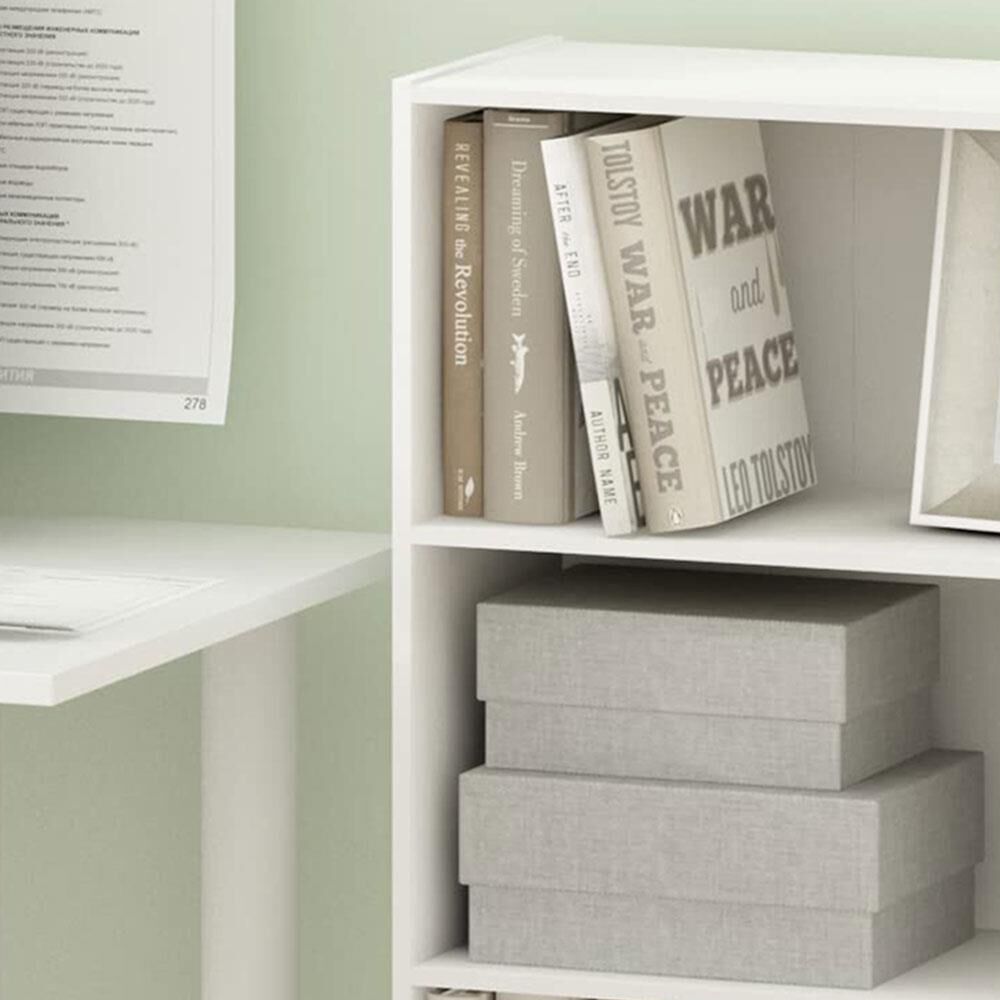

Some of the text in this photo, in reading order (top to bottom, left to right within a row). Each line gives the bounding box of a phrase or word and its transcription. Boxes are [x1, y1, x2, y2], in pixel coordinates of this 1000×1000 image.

[602, 140, 643, 226] TOLSTOY
[679, 173, 776, 258] WAR
[454, 143, 472, 366] REVEALING the Revolution
[508, 160, 528, 317] Dreaming of Sweden
[554, 184, 572, 223] AFTER
[564, 251, 581, 278] END
[620, 240, 655, 336] WAR
[730, 267, 765, 313] and
[183, 396, 207, 410] 278
[706, 330, 799, 407] PEACE
[513, 410, 527, 500] Andrew Brown
[591, 410, 617, 505] AUTHOR NAME
[640, 368, 683, 493] PEACE
[722, 434, 815, 516] LEO TOLSTOY
